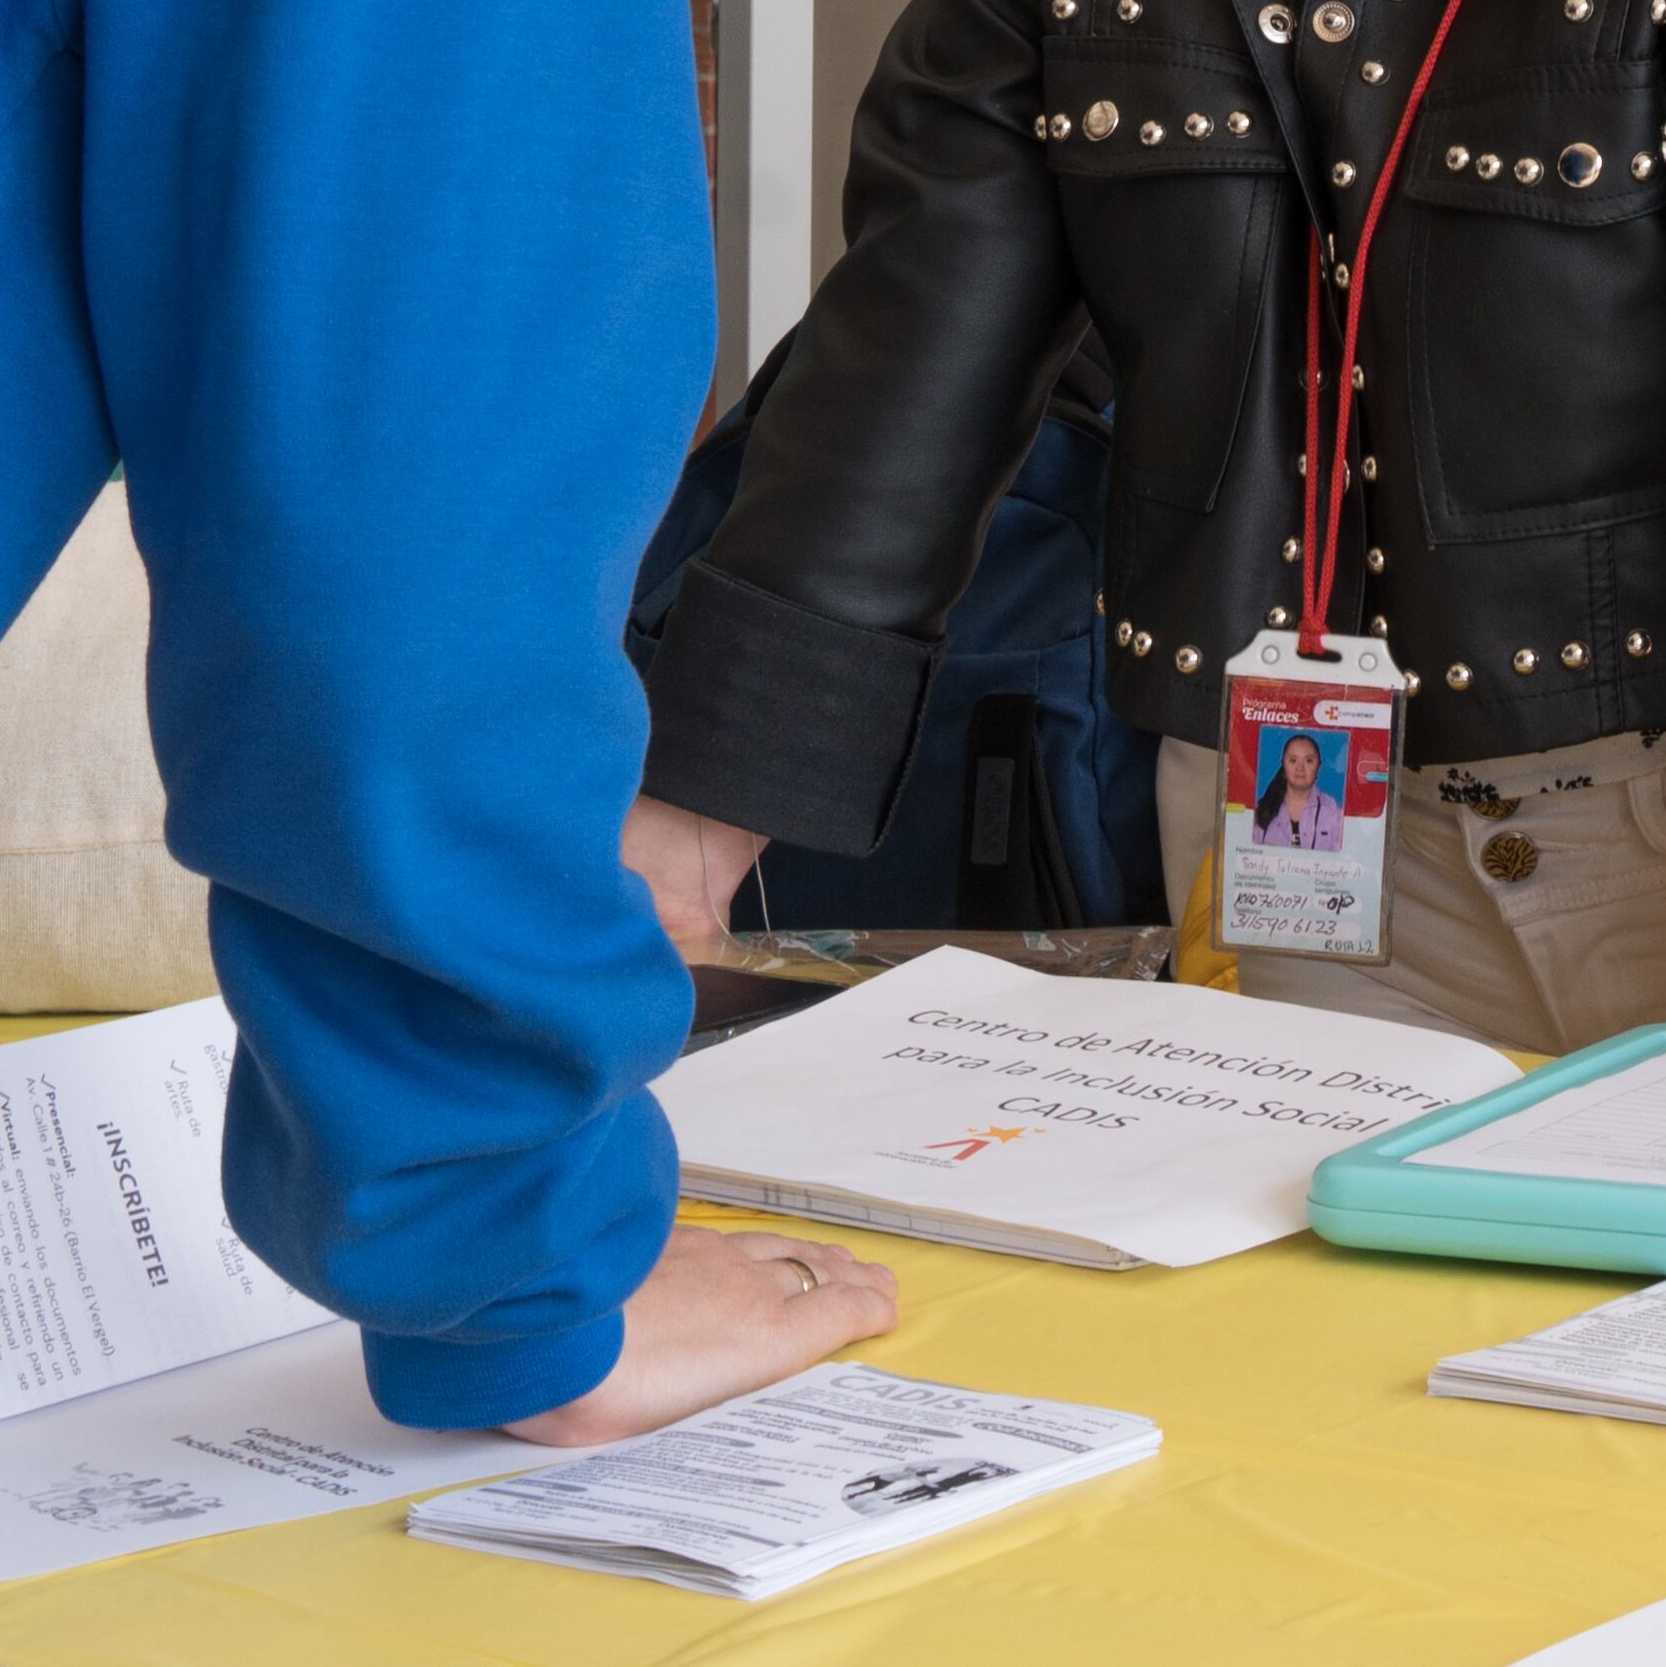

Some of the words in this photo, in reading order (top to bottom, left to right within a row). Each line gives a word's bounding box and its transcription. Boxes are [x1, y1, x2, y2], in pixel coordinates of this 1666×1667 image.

[1242, 697, 1287, 710] Programa
[1242, 707, 1299, 724] Enlaces
[1236, 847, 1263, 855] Nombre
[907, 1008, 1051, 1044] Centro
[1053, 1031, 1114, 1054] de
[1114, 1035, 1314, 1086] Atención
[176, 1080, 195, 1117] Ruta
[189, 1117, 202, 1138] de
[883, 1043, 991, 1074] para
[1001, 1057, 1037, 1077] la
[1040, 1065, 1240, 1113] Inclusión
[1241, 1099, 1391, 1134] Social
[997, 1096, 1143, 1131] CADIS
[45, 1091, 76, 1178] Presencial:
[1, 1180, 12, 1193] al
[32, 1102, 50, 1145] Calle
[62, 1230, 86, 1284] (Barrio
[96, 1121, 170, 1289] ¡INSCRÍBETE!
[0, 1101, 20, 1162] Virtual:
[15, 1168, 41, 1240] enviando
[35, 1245, 47, 1270] los
[44, 1276, 82, 1377] documentos
[6, 1199, 26, 1253] correo
[240, 1276, 252, 1296] de
[1, 1244, 12, 1267] de
[7, 1273, 34, 1345] contacto
[30, 1351, 46, 1387] para
[27, 1276, 55, 1354] refiriendo
[18, 1372, 29, 1391] se
[51, 1360, 64, 1382] un
[829, 1375, 985, 1411] CADIS
[172, 1434, 241, 1462] Inclusión
[239, 1457, 296, 1476] Social
[295, 1476, 358, 1497] CADIS
[231, 1437, 300, 1463] Distrital
[285, 1459, 332, 1475] para
[330, 1470, 349, 1479] la
[245, 1427, 301, 1448] Centro
[298, 1443, 324, 1455] de
[323, 1451, 395, 1477] Atención
